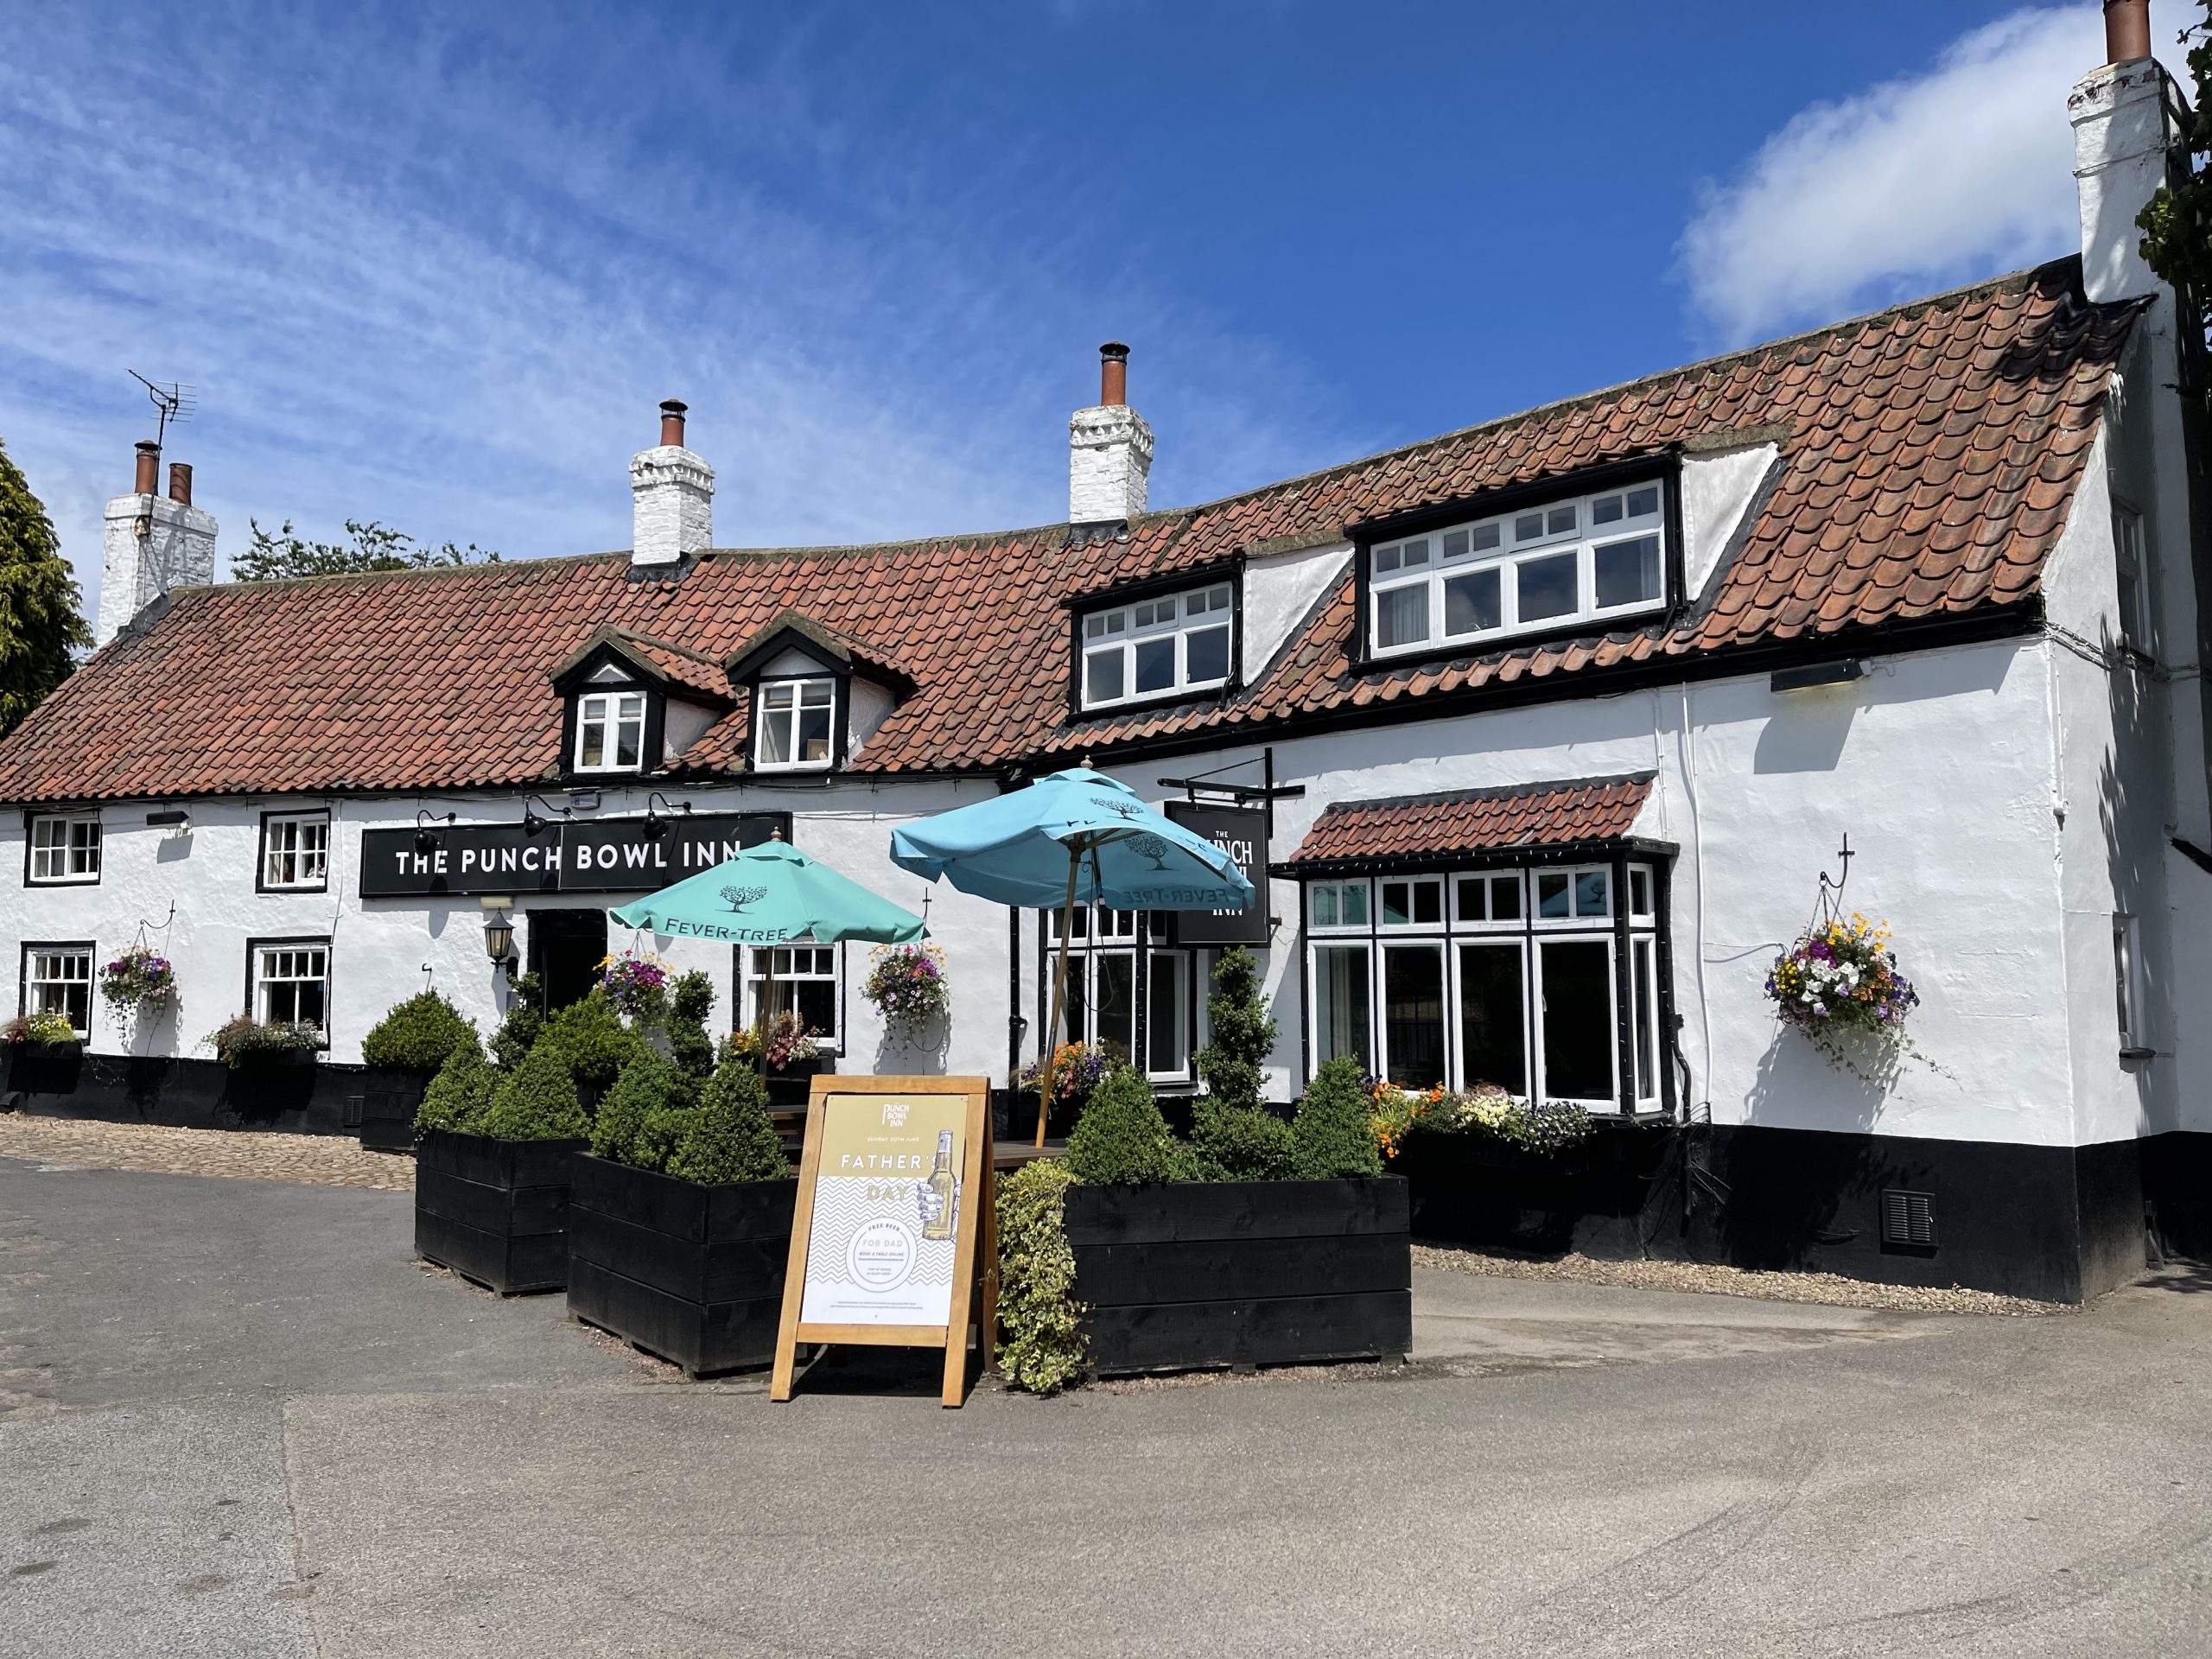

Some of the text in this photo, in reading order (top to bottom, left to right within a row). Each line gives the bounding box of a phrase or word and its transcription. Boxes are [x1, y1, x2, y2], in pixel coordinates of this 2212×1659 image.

[395, 840, 741, 874] THE PUNCH BOWL INN
[882, 1103, 910, 1125] PUNCH
[868, 1185, 910, 1201] DAY
[862, 1239, 903, 1248] FOR DAD
